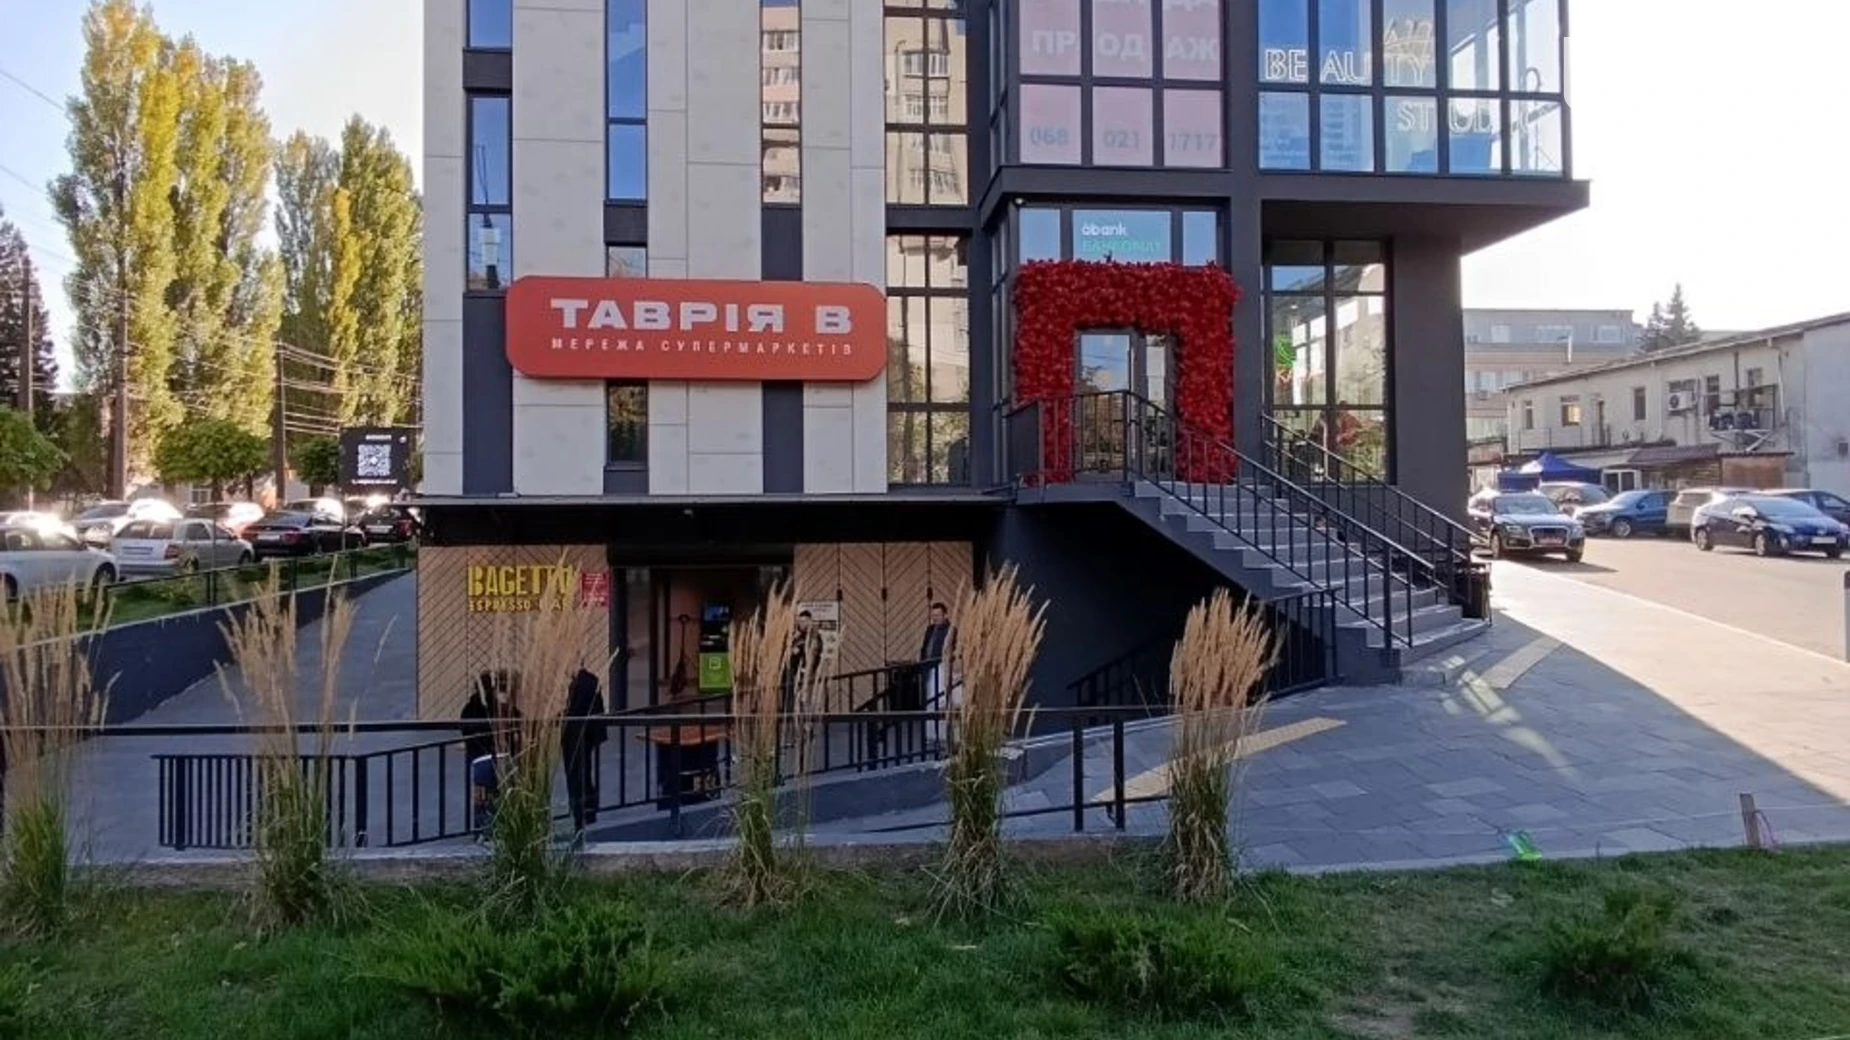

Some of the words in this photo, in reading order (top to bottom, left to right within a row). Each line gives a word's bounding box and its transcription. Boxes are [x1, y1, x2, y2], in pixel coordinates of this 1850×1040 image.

[1264, 48, 1429, 84] BEAUTY
[1029, 126, 1070, 146] 068
[1103, 129, 1141, 149] 021
[550, 298, 784, 332] ТАВРІЯ
[815, 305, 853, 335] В
[551, 337, 645, 352] МЕРЕЖА
[661, 341, 853, 356] СУПЕРМАРКЕТІВ
[468, 565, 574, 596] BAGETTO
